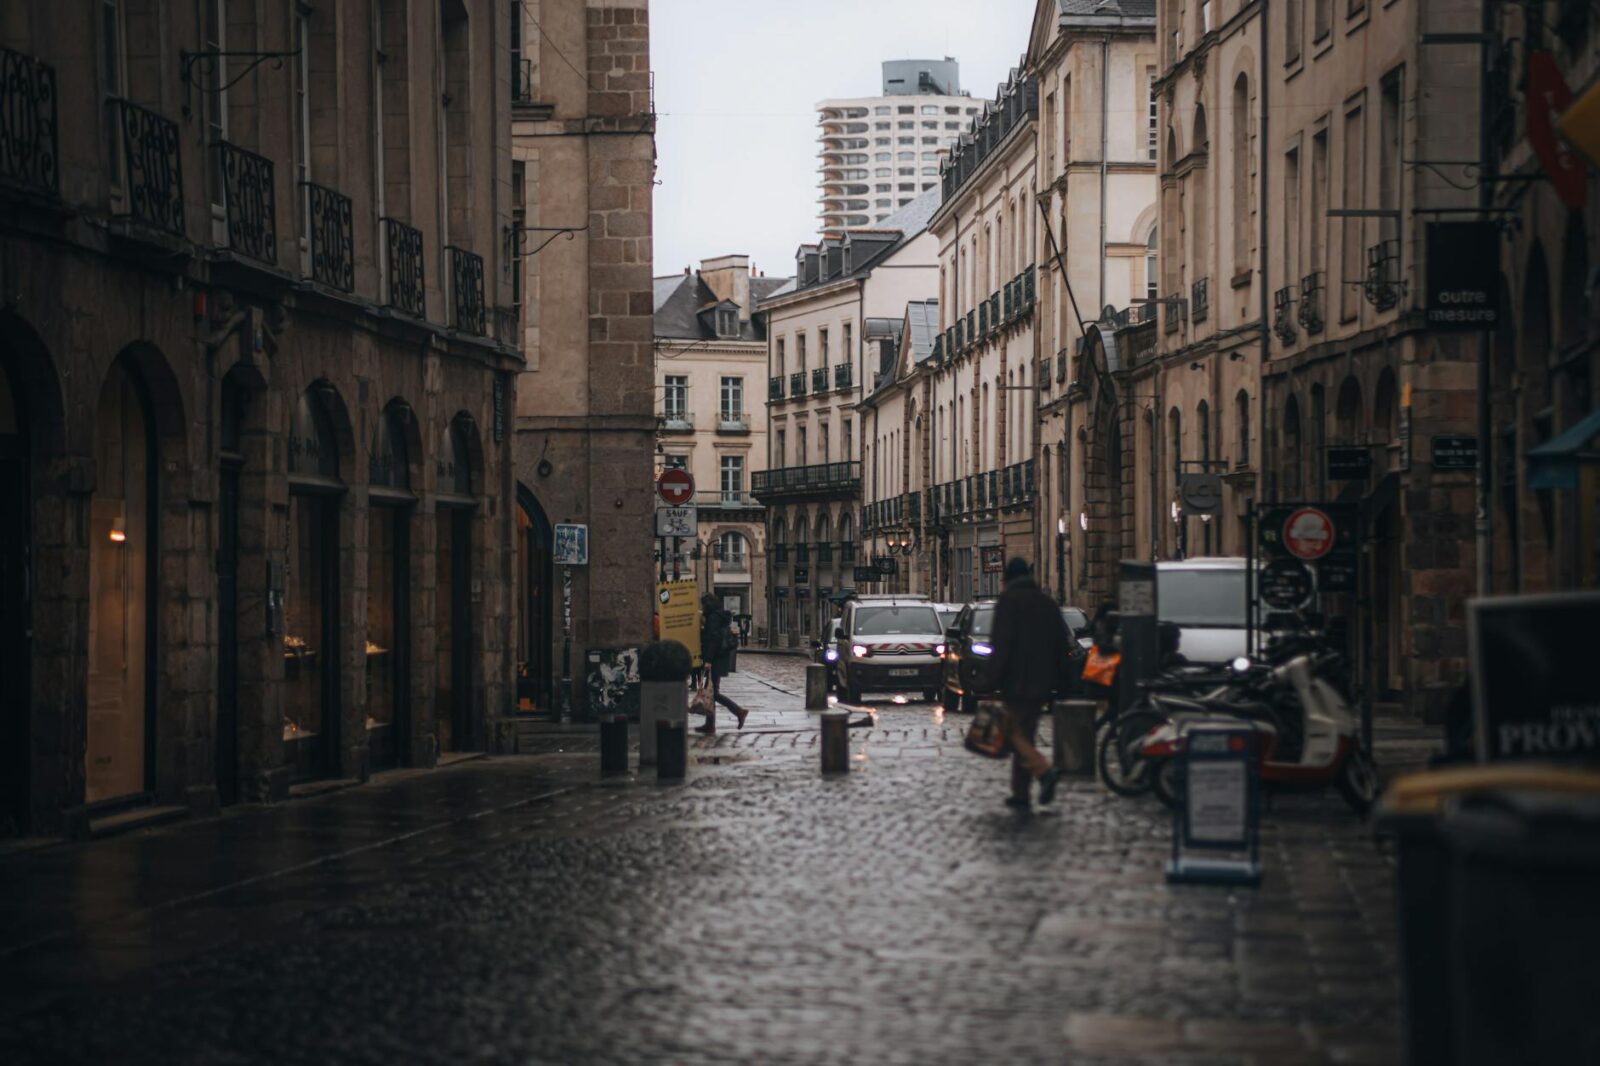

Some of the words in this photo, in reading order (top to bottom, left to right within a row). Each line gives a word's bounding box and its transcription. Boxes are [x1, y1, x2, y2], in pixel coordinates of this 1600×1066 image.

[1438, 290, 1487, 304] outre
[1428, 309, 1496, 322] mesure
[666, 509, 688, 518] SAUF
